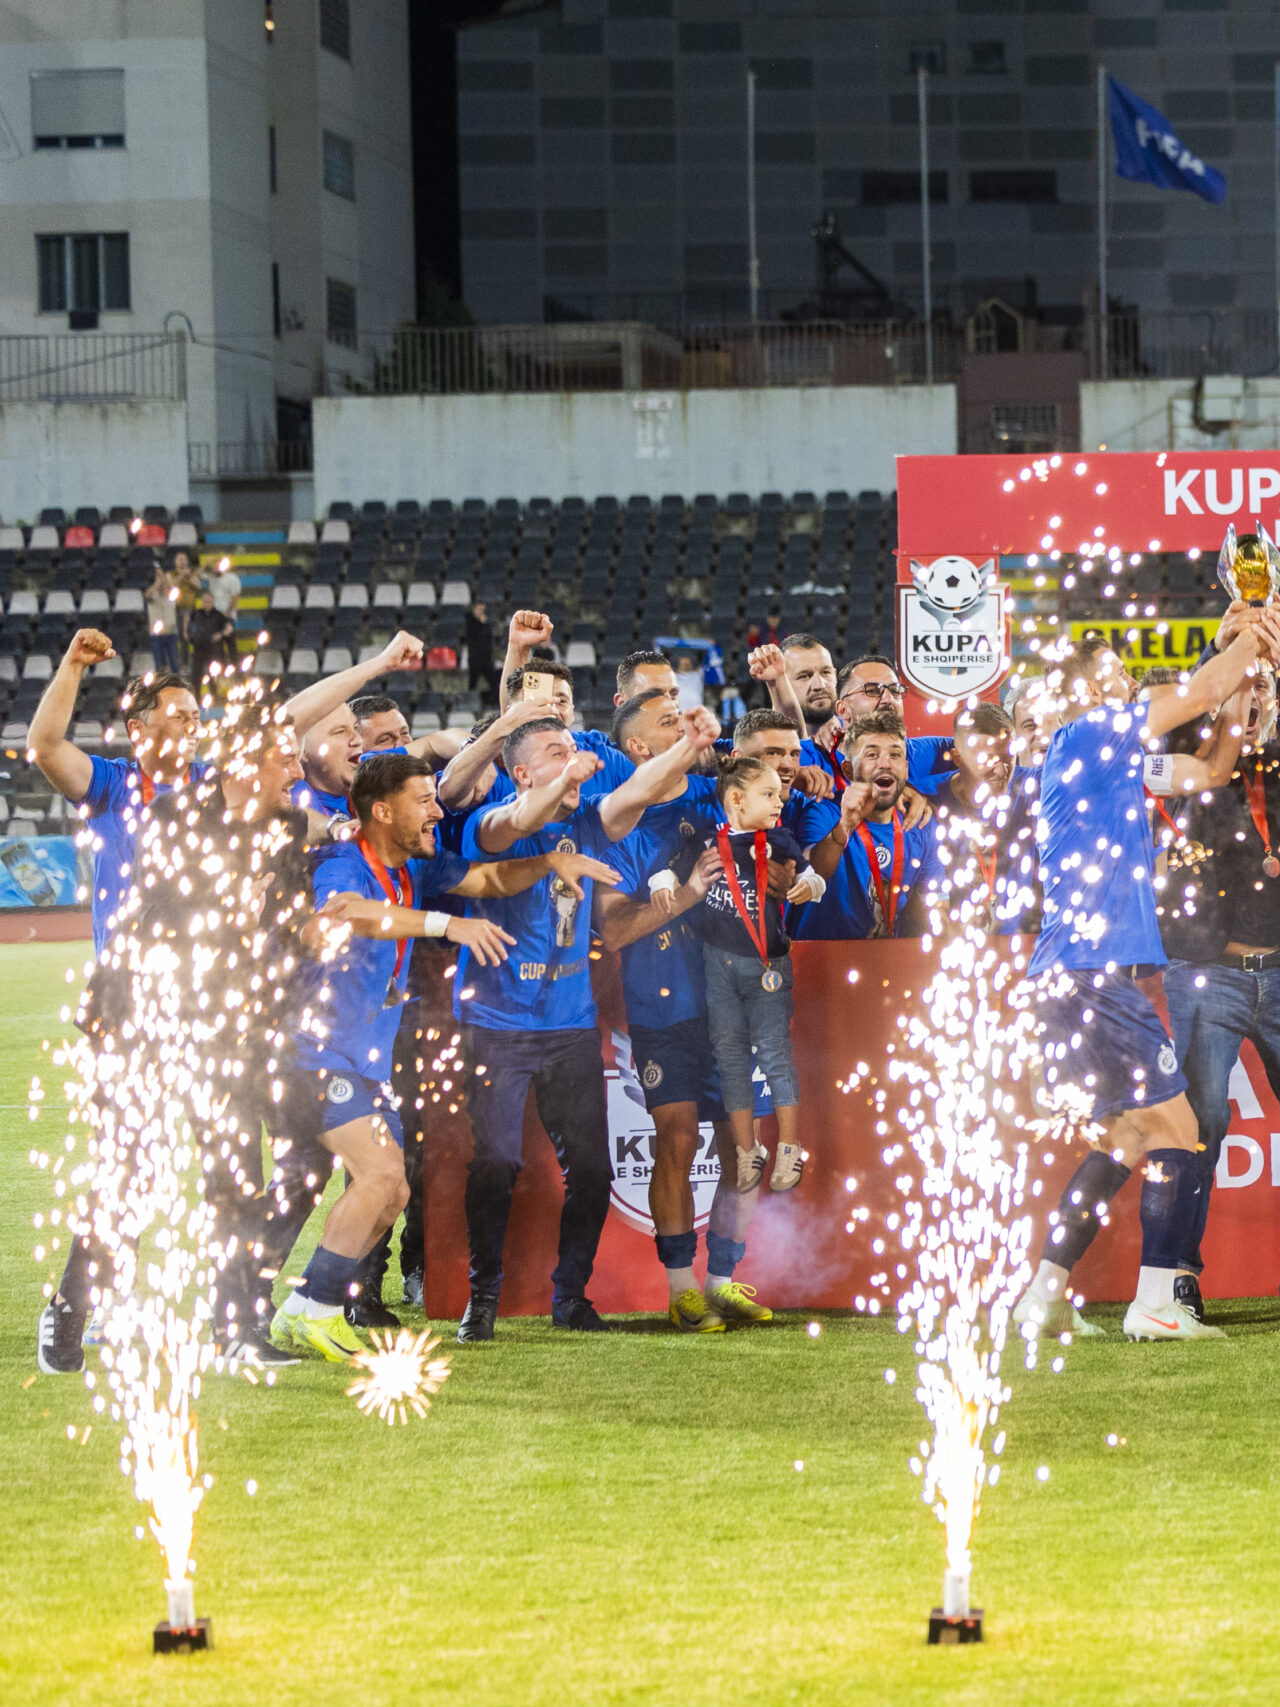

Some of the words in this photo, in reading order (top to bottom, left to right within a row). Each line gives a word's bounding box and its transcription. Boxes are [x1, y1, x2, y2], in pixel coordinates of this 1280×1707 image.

[912, 635, 992, 652] KUPA
[913, 655, 920, 663] E
[519, 962, 546, 981] CUP
[617, 1166, 627, 1178] E
